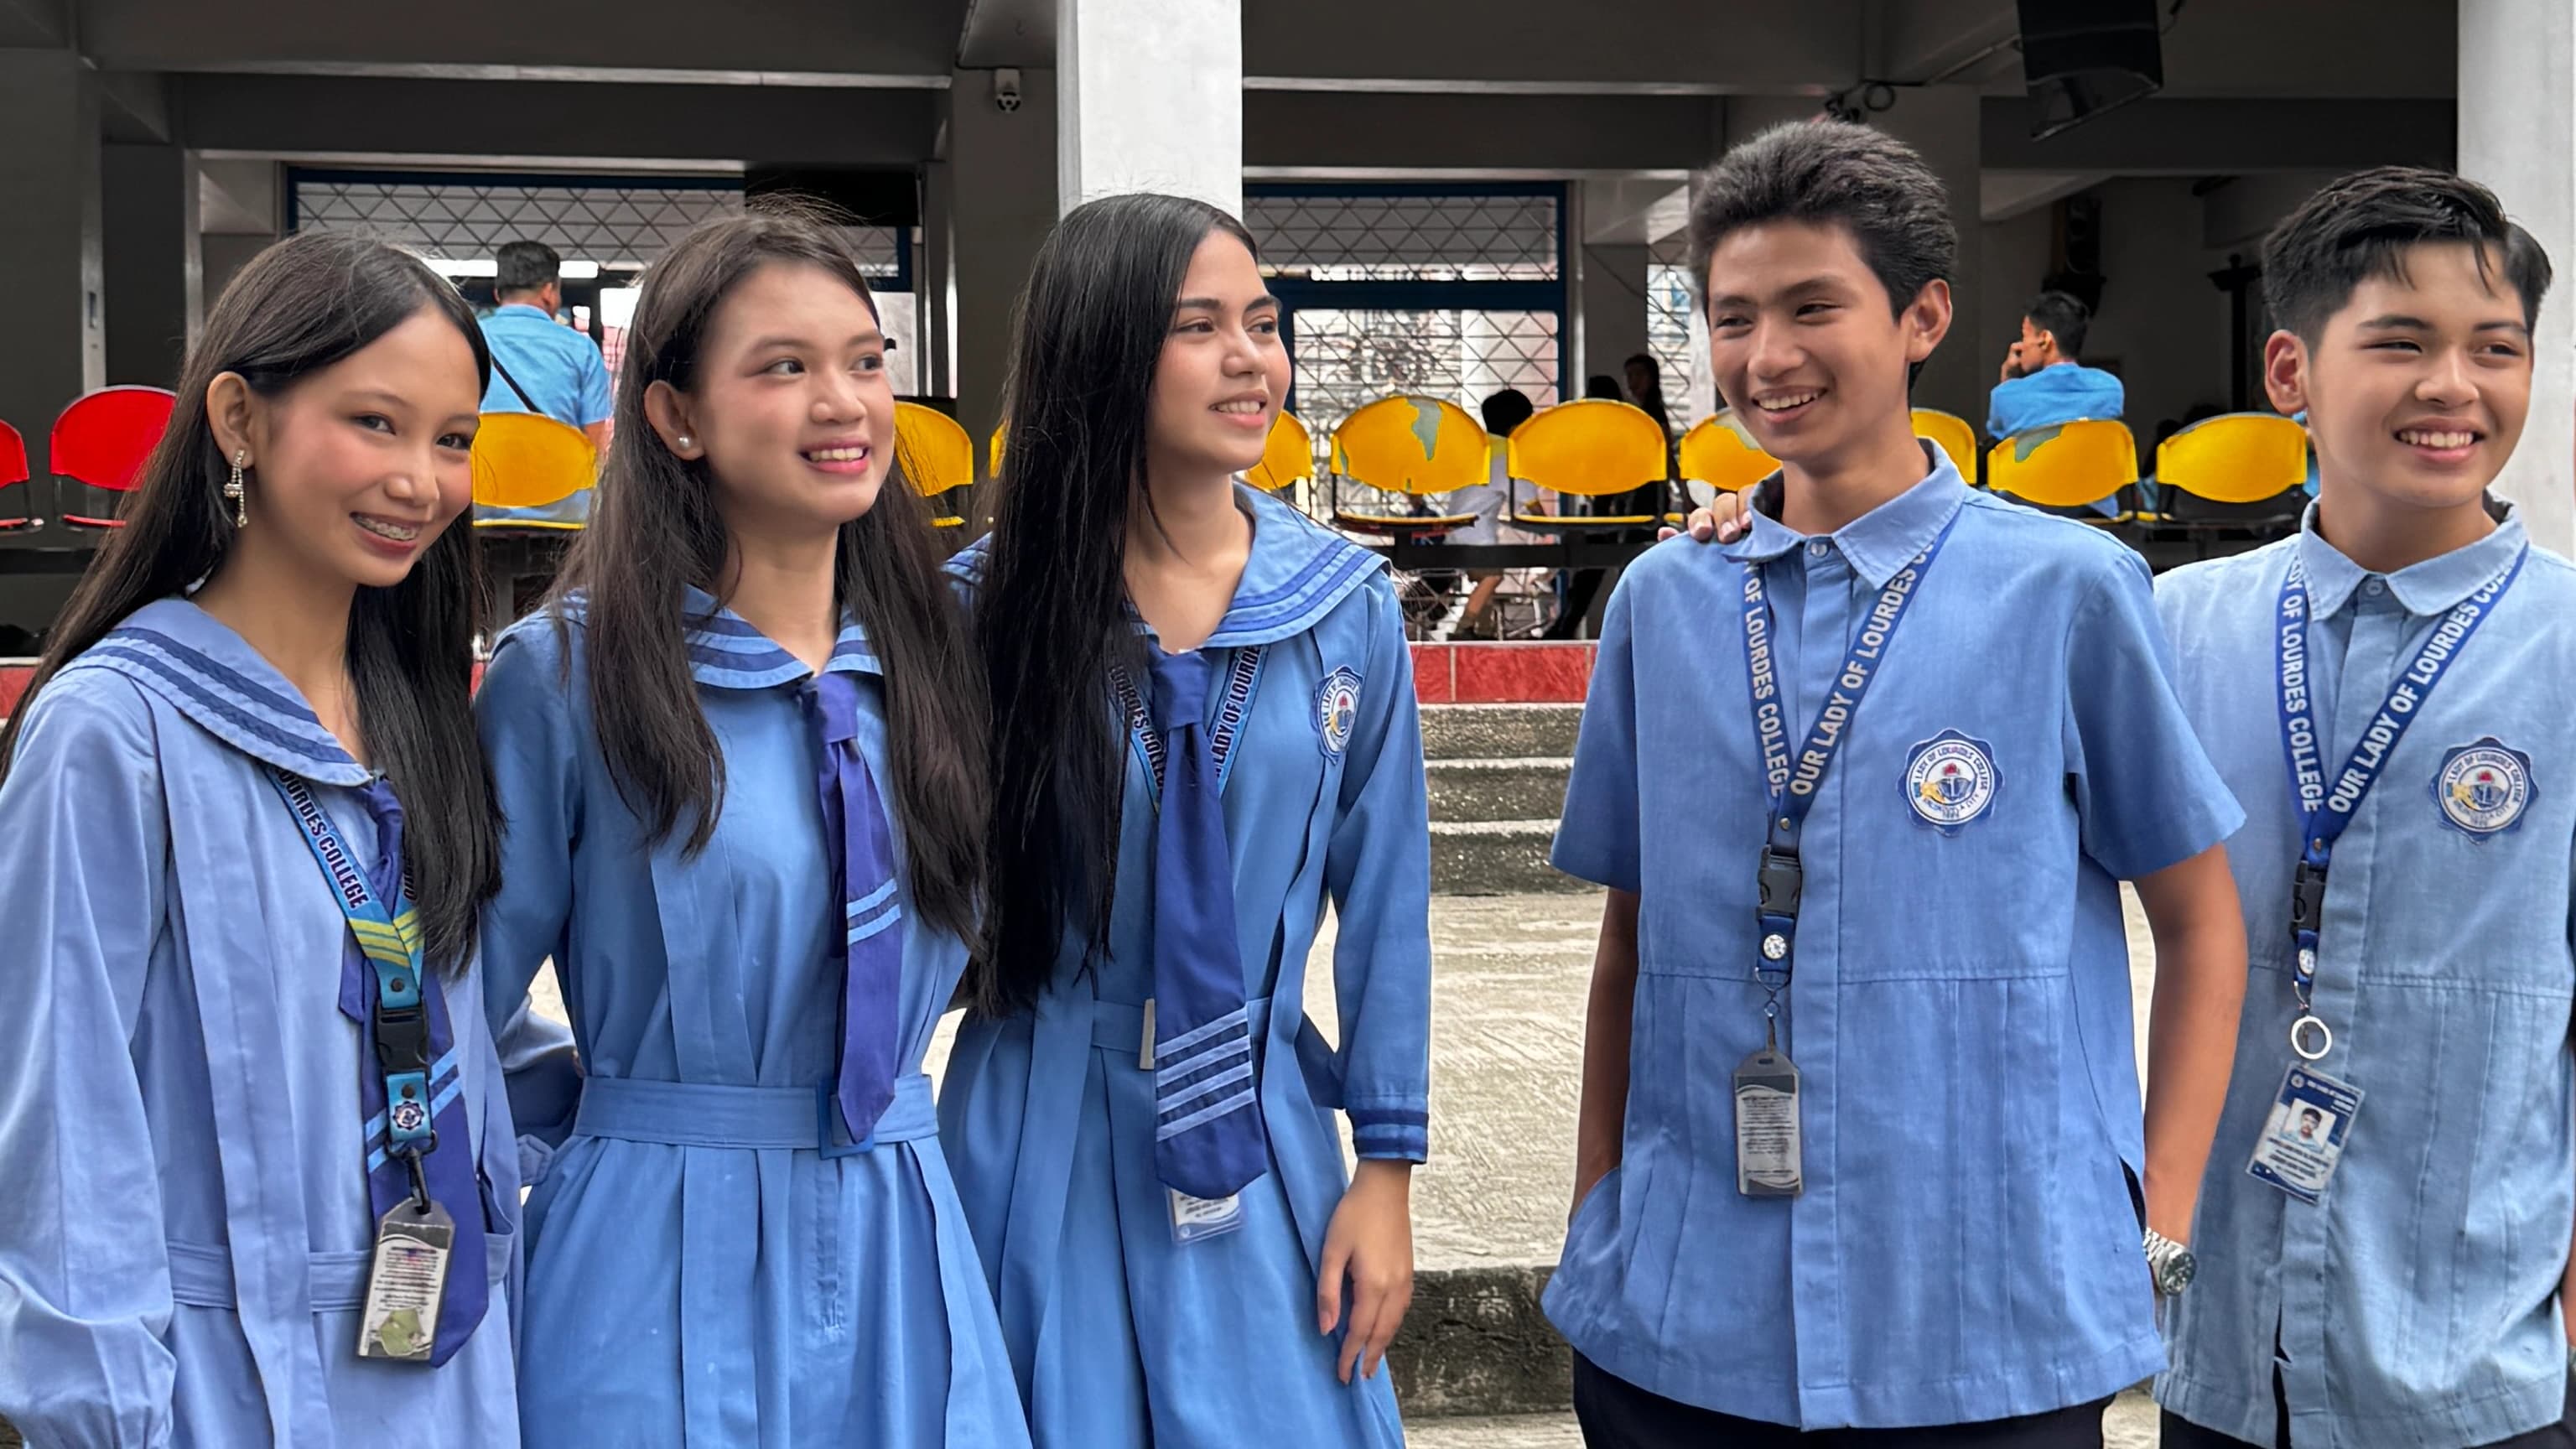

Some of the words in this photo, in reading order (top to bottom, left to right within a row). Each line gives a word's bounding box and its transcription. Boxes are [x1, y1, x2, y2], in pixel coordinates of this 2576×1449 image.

[1744, 577, 1763, 603] OF
[2283, 594, 2303, 619] OF
[1745, 605, 1775, 701] LOURDES
[1789, 750, 1828, 796] OUR
[1812, 691, 1855, 748] LADY
[1840, 661, 1869, 690] OF
[1856, 569, 1917, 660] LOURDES
[2282, 621, 2307, 714] LOURDES
[1211, 724, 1236, 766] LADY
[1222, 703, 1243, 724] OF
[2328, 771, 2370, 814] OUR
[2354, 712, 2400, 770] LADY
[2389, 683, 2420, 715] OF
[2414, 602, 2480, 686] LOURDES
[2288, 717, 2324, 813] COLLEGE
[274, 770, 327, 836] OURDES
[318, 836, 369, 909] COLLEGE
